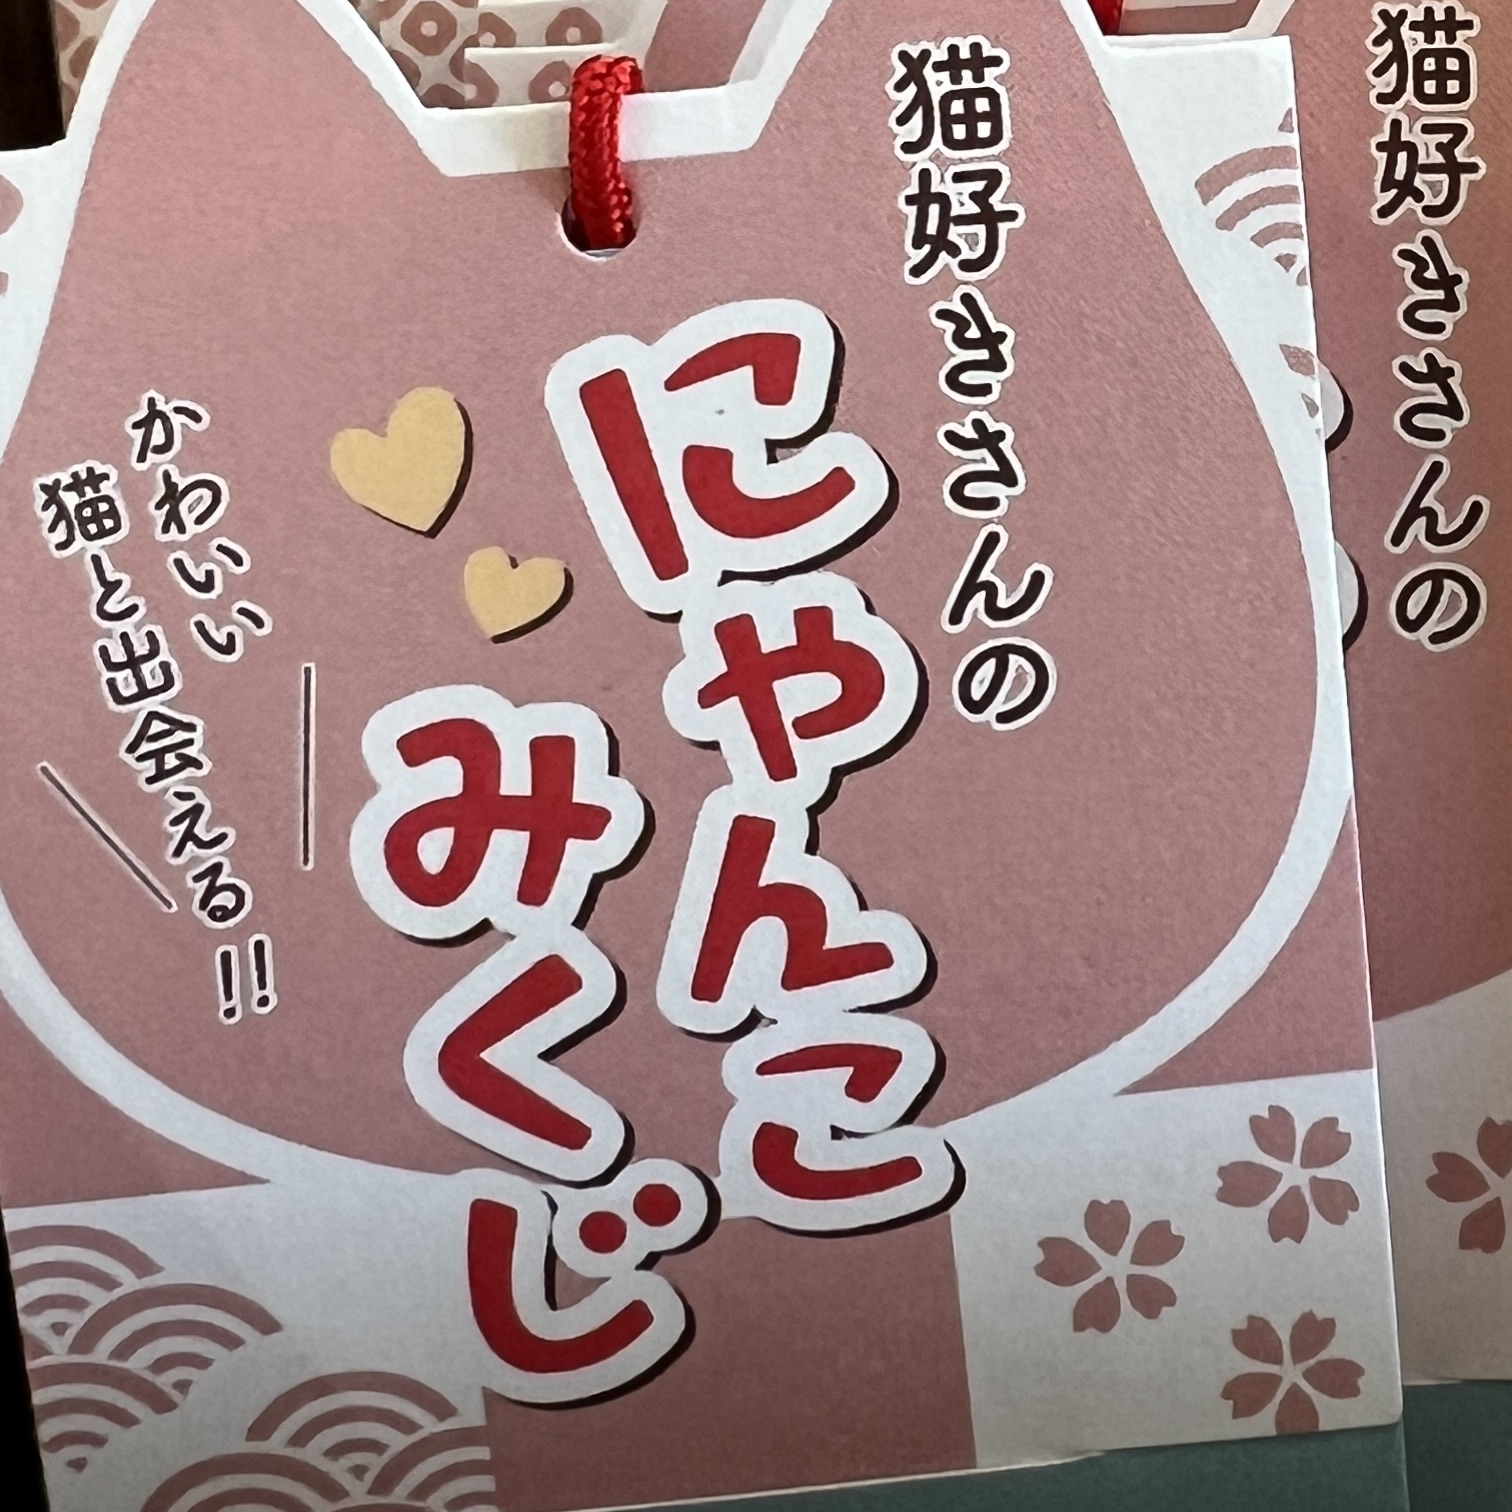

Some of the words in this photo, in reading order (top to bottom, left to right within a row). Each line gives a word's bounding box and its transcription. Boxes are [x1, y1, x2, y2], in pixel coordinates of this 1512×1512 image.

[132, 396, 266, 656] かわいい
[894, 43, 1052, 725] 猫好きさんの
[1372, 6, 1482, 646] 猫好きさんの
[384, 717, 682, 1374] みくじ
